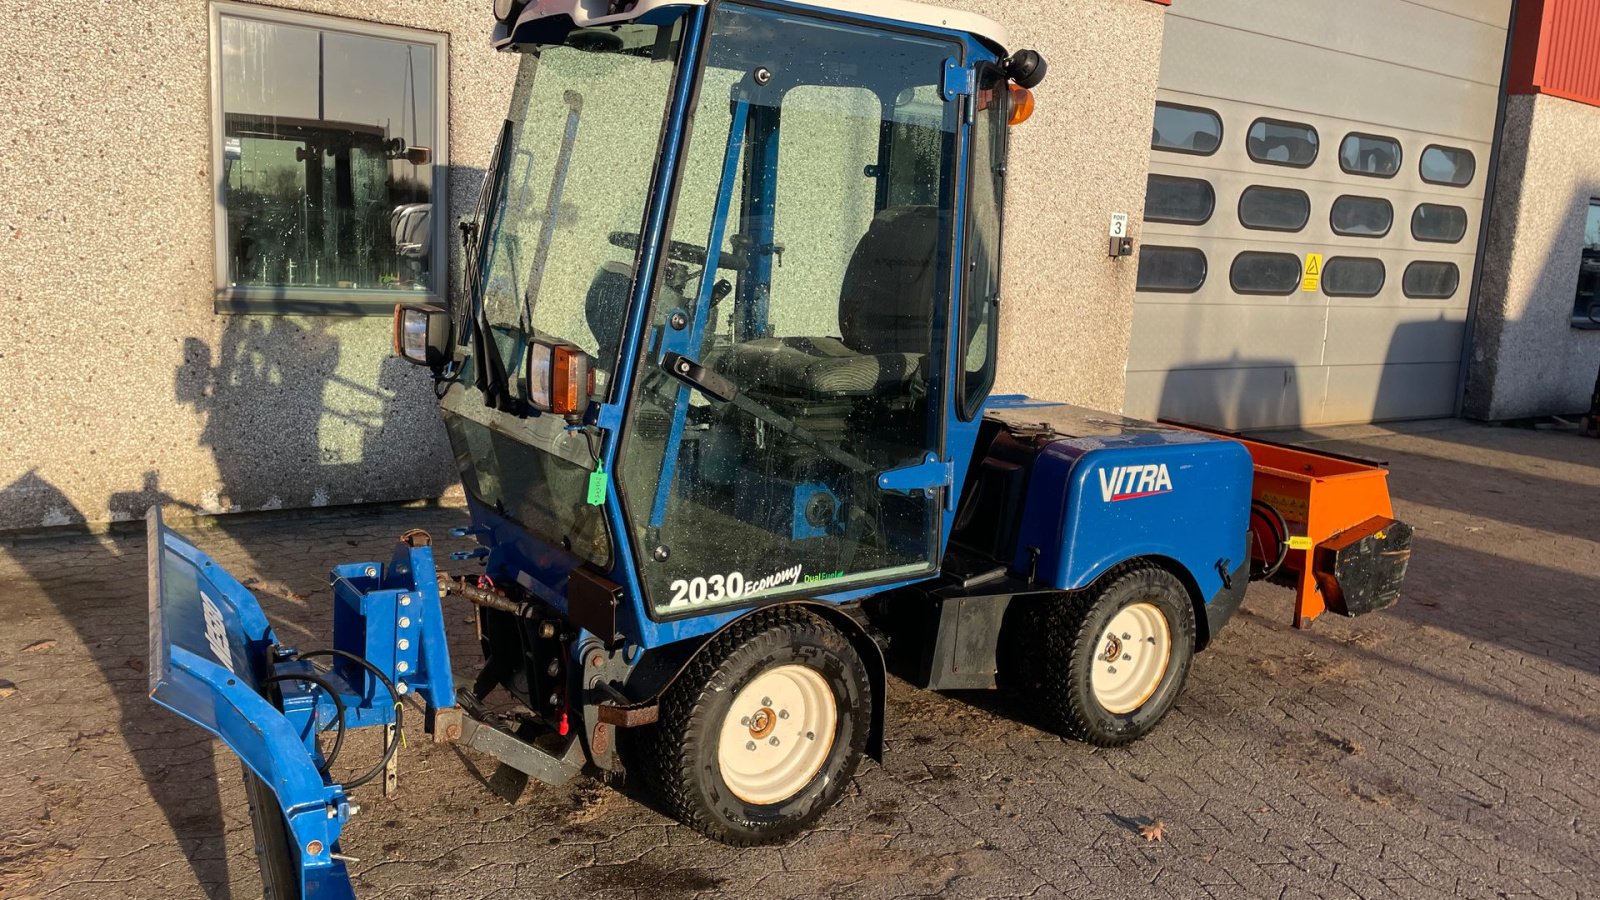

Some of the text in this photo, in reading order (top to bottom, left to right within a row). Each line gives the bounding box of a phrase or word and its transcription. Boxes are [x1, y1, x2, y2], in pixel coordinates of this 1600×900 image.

[1114, 221, 1122, 235] 3
[1098, 463, 1173, 502] VITRA
[669, 571, 745, 608] 2030
[744, 563, 803, 597] Economy
